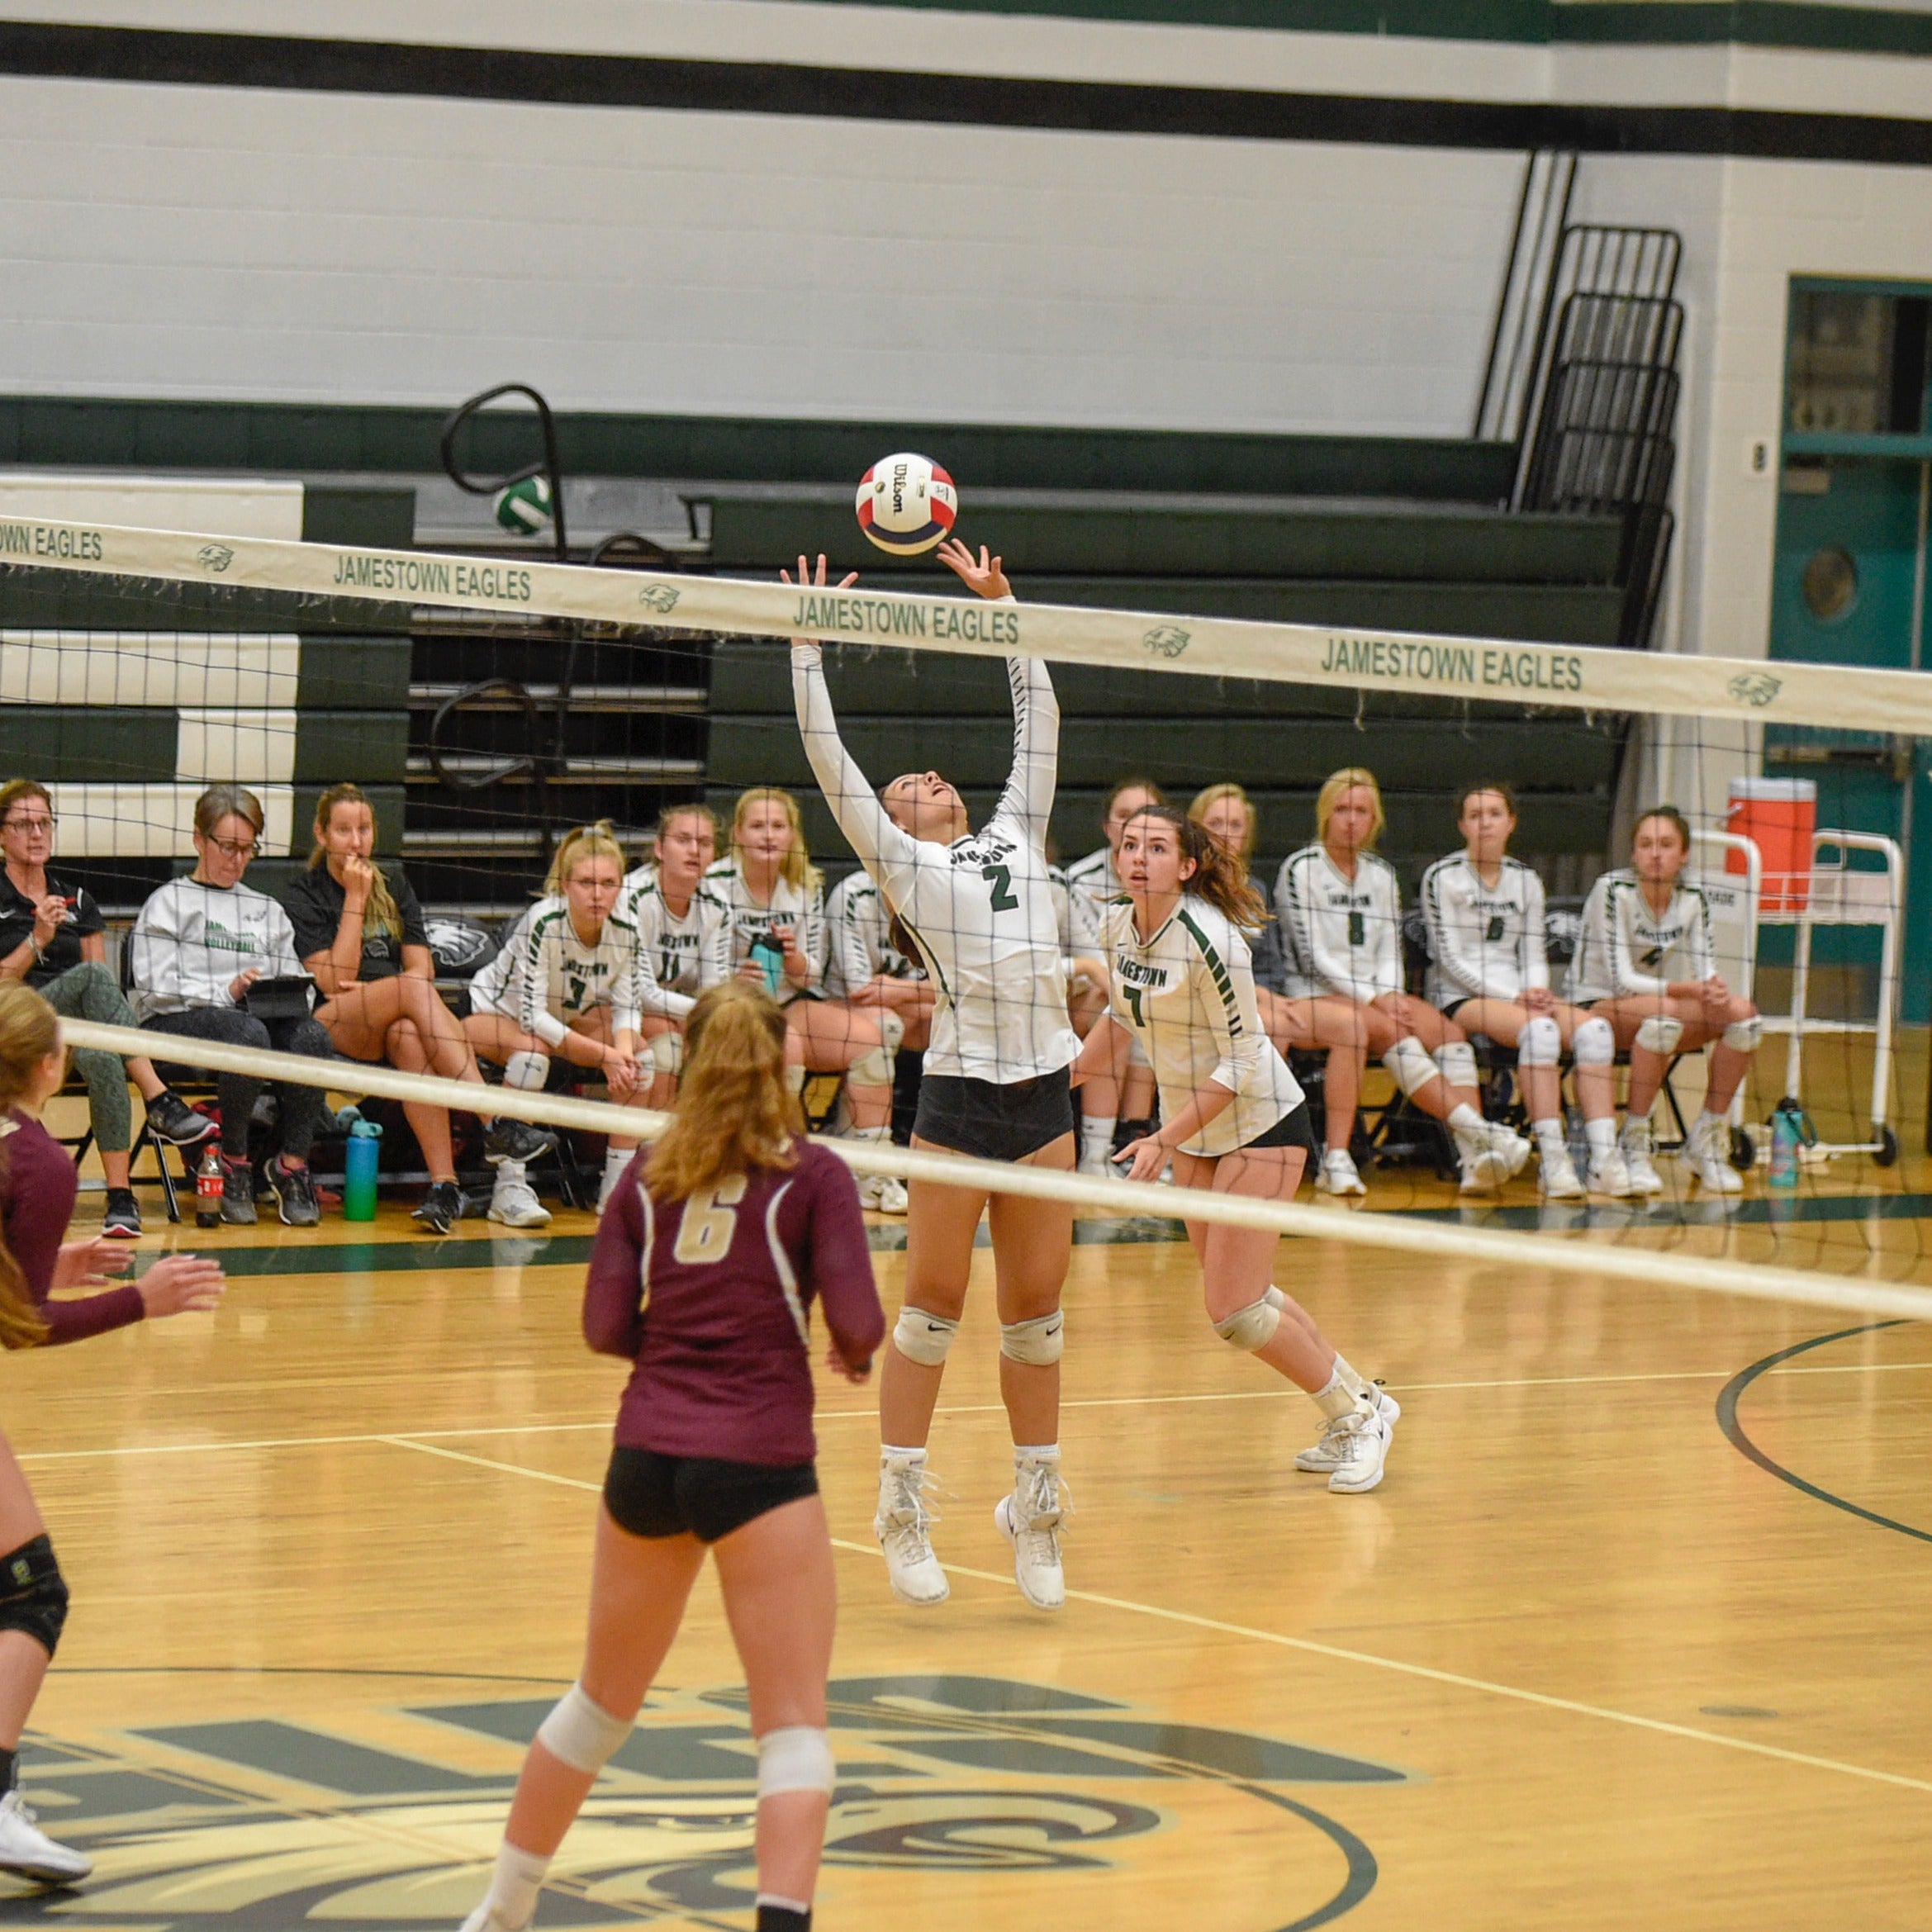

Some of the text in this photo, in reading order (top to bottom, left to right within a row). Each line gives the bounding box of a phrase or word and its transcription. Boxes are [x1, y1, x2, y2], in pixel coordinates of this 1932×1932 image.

[893, 463, 907, 516] Wilson
[36, 527, 102, 561] EAGLES
[334, 554, 531, 602] JAMESTOWN EAGLES
[793, 596, 1019, 644] JAMESTOWN EAGLES
[1322, 638, 1582, 691] JAMESTOWN EAGLES
[981, 864, 1019, 912] 2
[1123, 984, 1146, 1028] 7
[673, 1174, 748, 1264] 6
